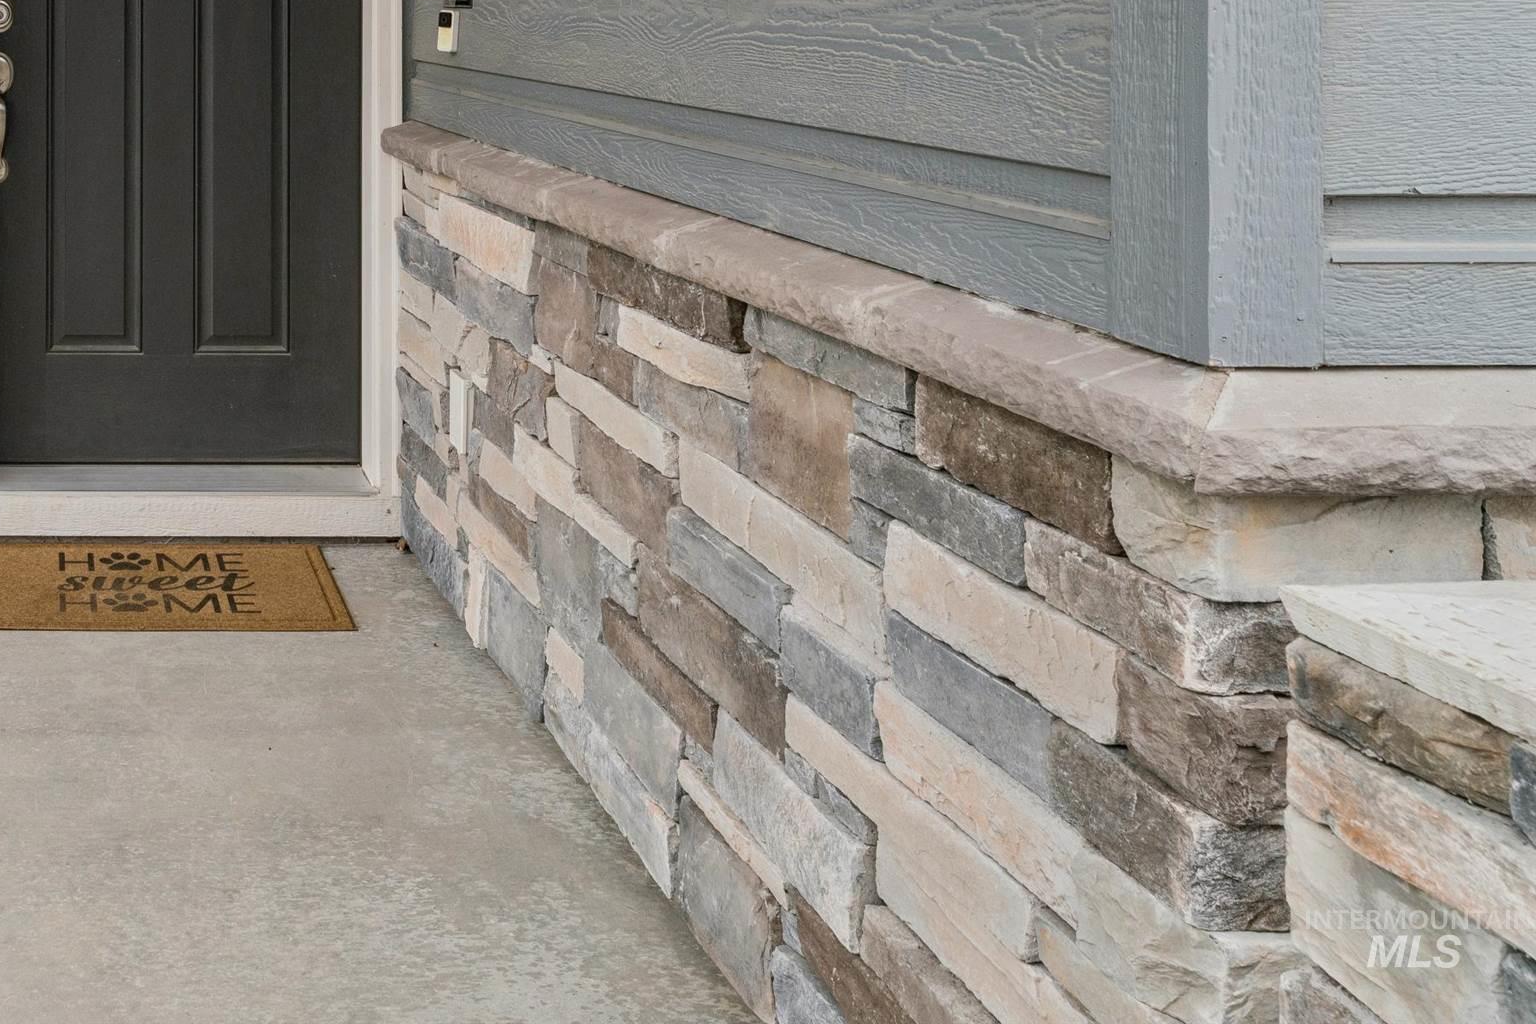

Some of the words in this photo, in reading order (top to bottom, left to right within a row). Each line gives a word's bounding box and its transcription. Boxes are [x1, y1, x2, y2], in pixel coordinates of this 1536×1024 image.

[58, 551, 250, 572] HME
[57, 572, 257, 591] sweet
[58, 592, 262, 614] HME
